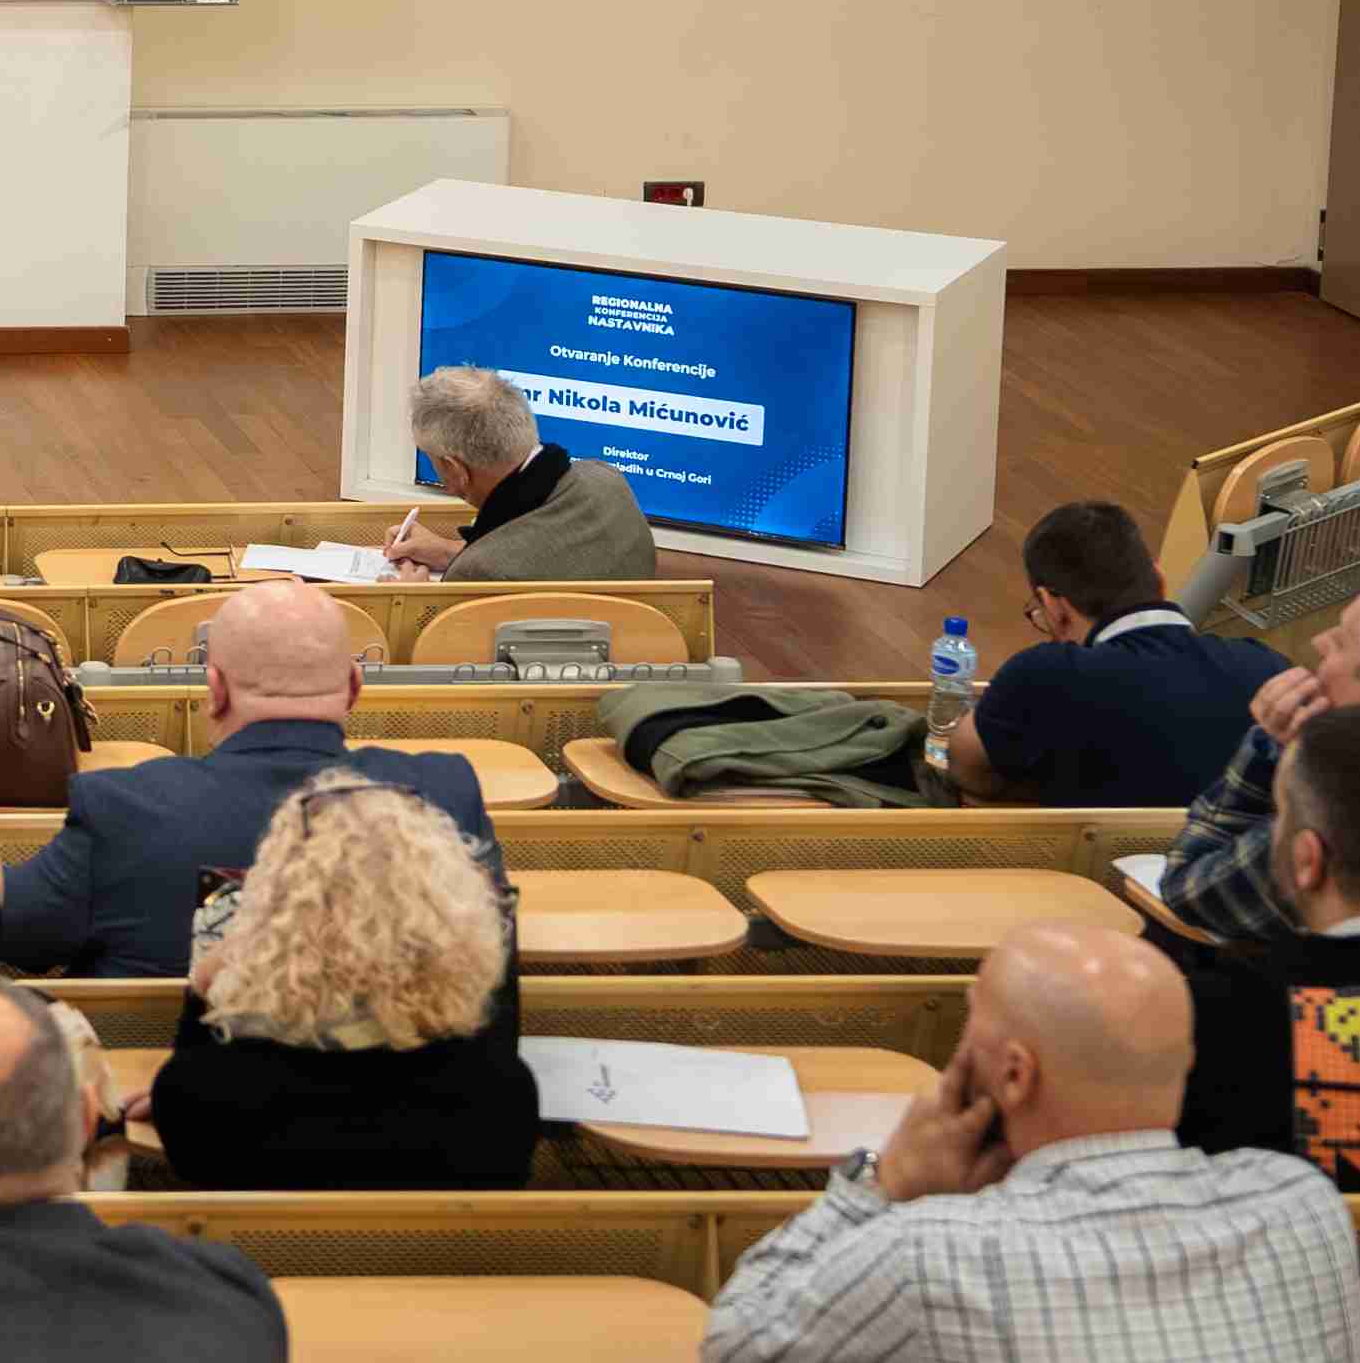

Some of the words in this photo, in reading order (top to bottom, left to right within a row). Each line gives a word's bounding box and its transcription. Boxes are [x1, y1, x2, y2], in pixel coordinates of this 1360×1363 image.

[591, 294, 673, 315] REGIONALNA
[594, 306, 668, 323] KONFERENCIJA
[587, 315, 675, 336] NASTAVNIKA
[549, 344, 621, 367] Otvaranje
[623, 354, 717, 380] Konferencije
[548, 388, 622, 414] Nikola
[628, 399, 750, 432] Mićunović
[603, 445, 650, 462] Direktor
[645, 468, 654, 477] u
[655, 468, 686, 484] Crnoj
[687, 473, 712, 485] Gori
